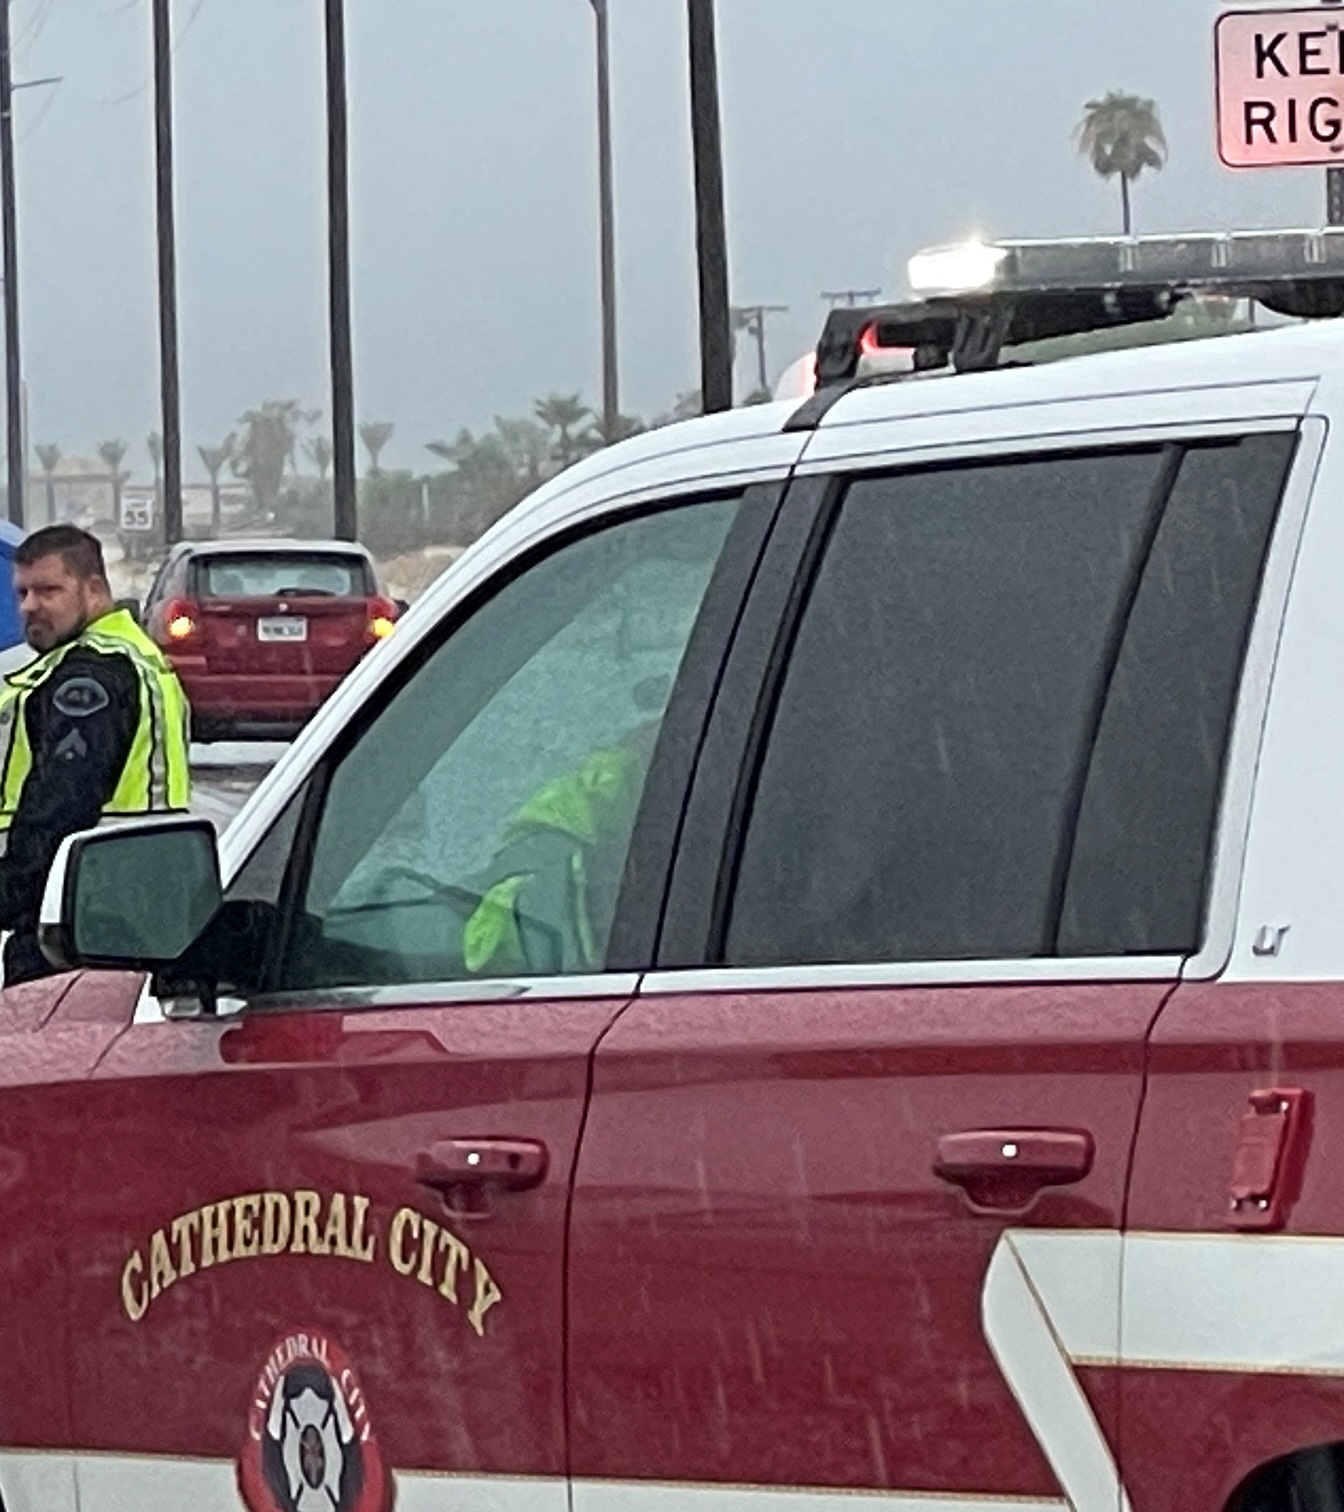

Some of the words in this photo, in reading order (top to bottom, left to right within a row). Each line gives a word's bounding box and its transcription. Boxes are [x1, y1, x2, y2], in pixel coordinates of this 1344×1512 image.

[1254, 30, 1344, 79] KE
[124, 510, 149, 526] 55
[120, 1190, 376, 1322] CATHEDRAL
[389, 1207, 502, 1337] CITY
